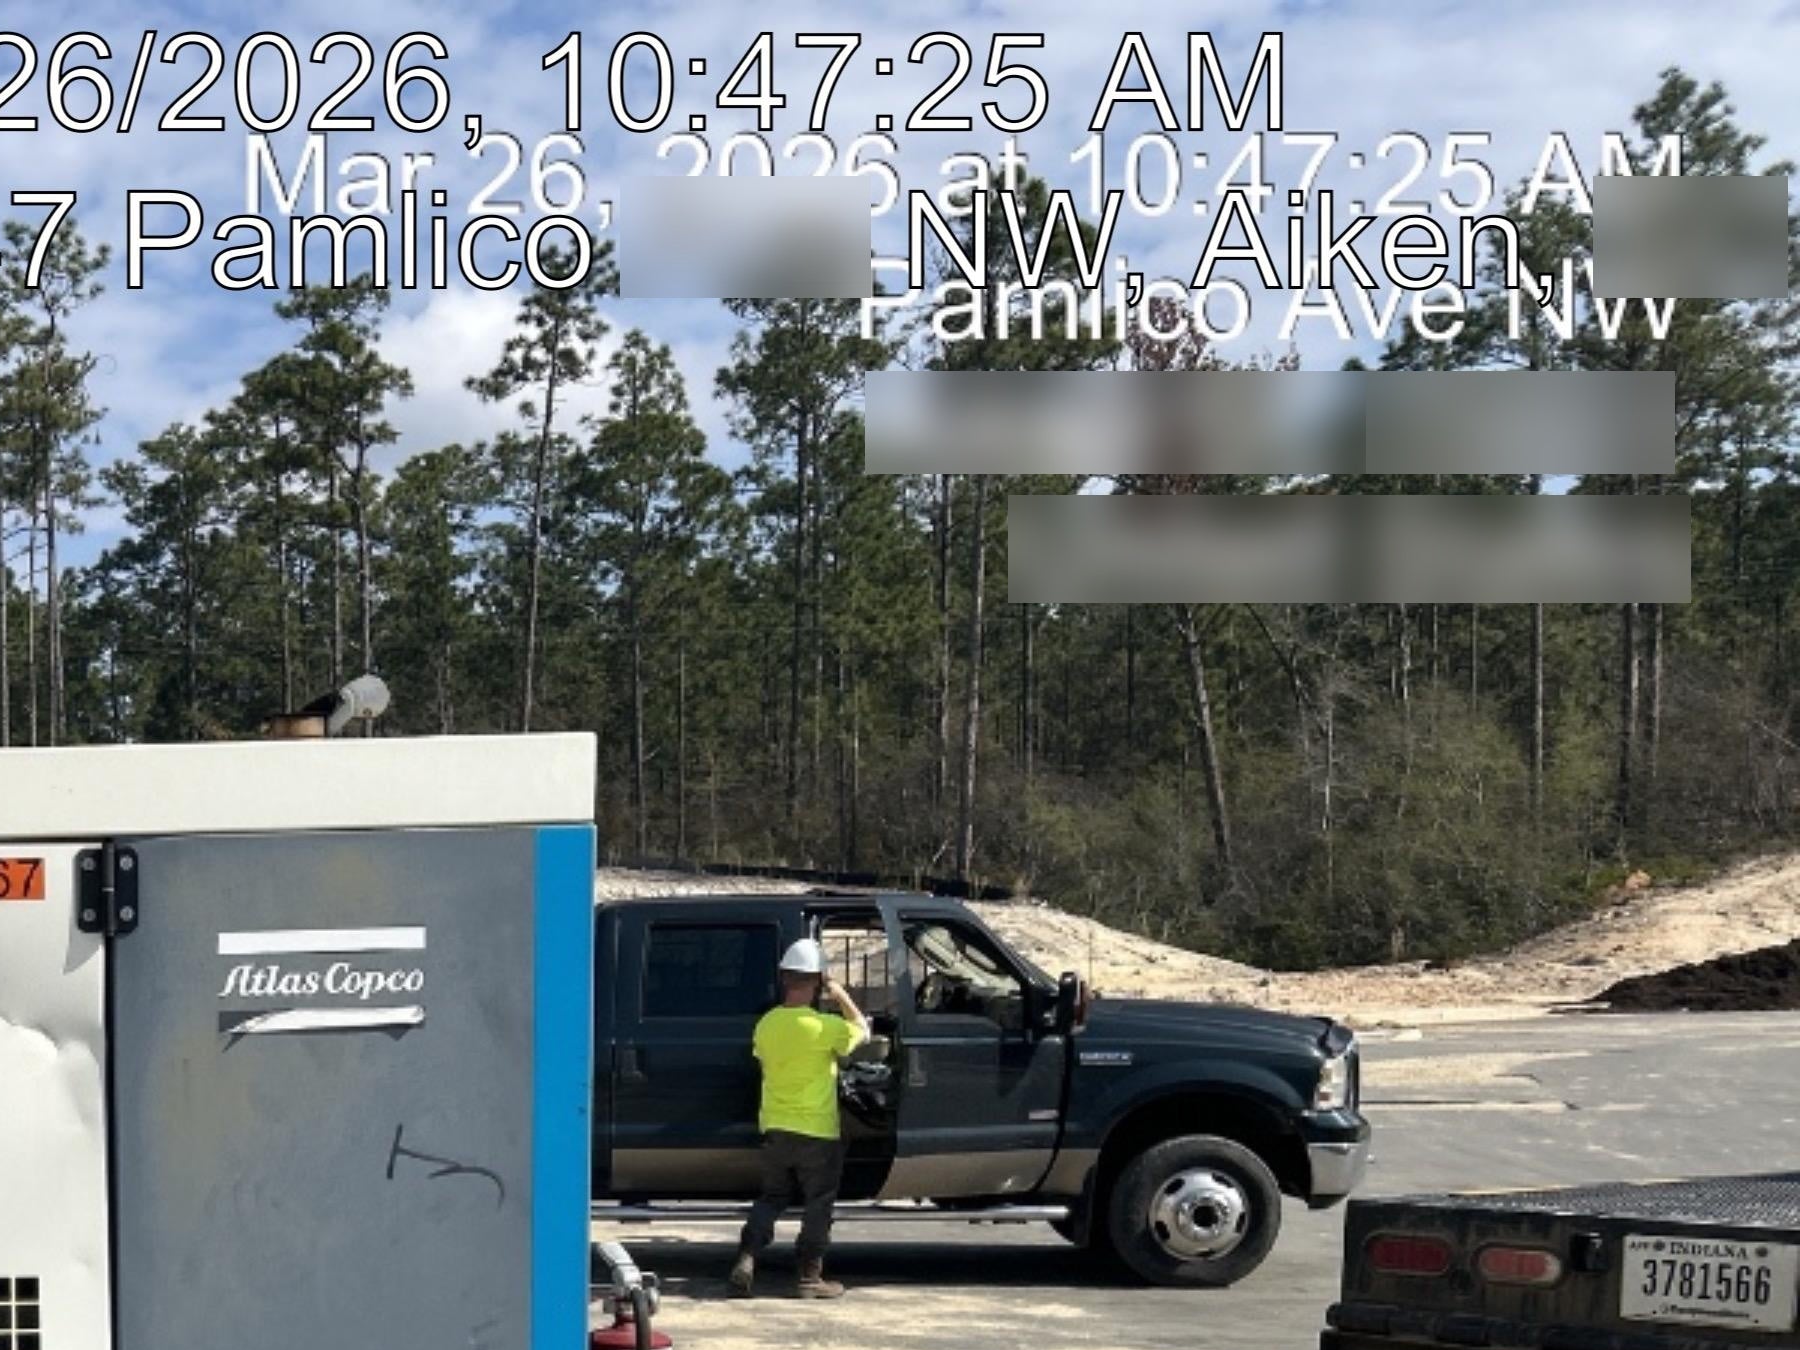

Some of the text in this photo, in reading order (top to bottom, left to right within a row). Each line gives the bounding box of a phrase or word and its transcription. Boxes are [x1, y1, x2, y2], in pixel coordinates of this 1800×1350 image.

[217, 961, 425, 1000] Atlas Copco
[1670, 1241, 1748, 1259] INDIANA
[1642, 1259, 1772, 1305] 3781566
